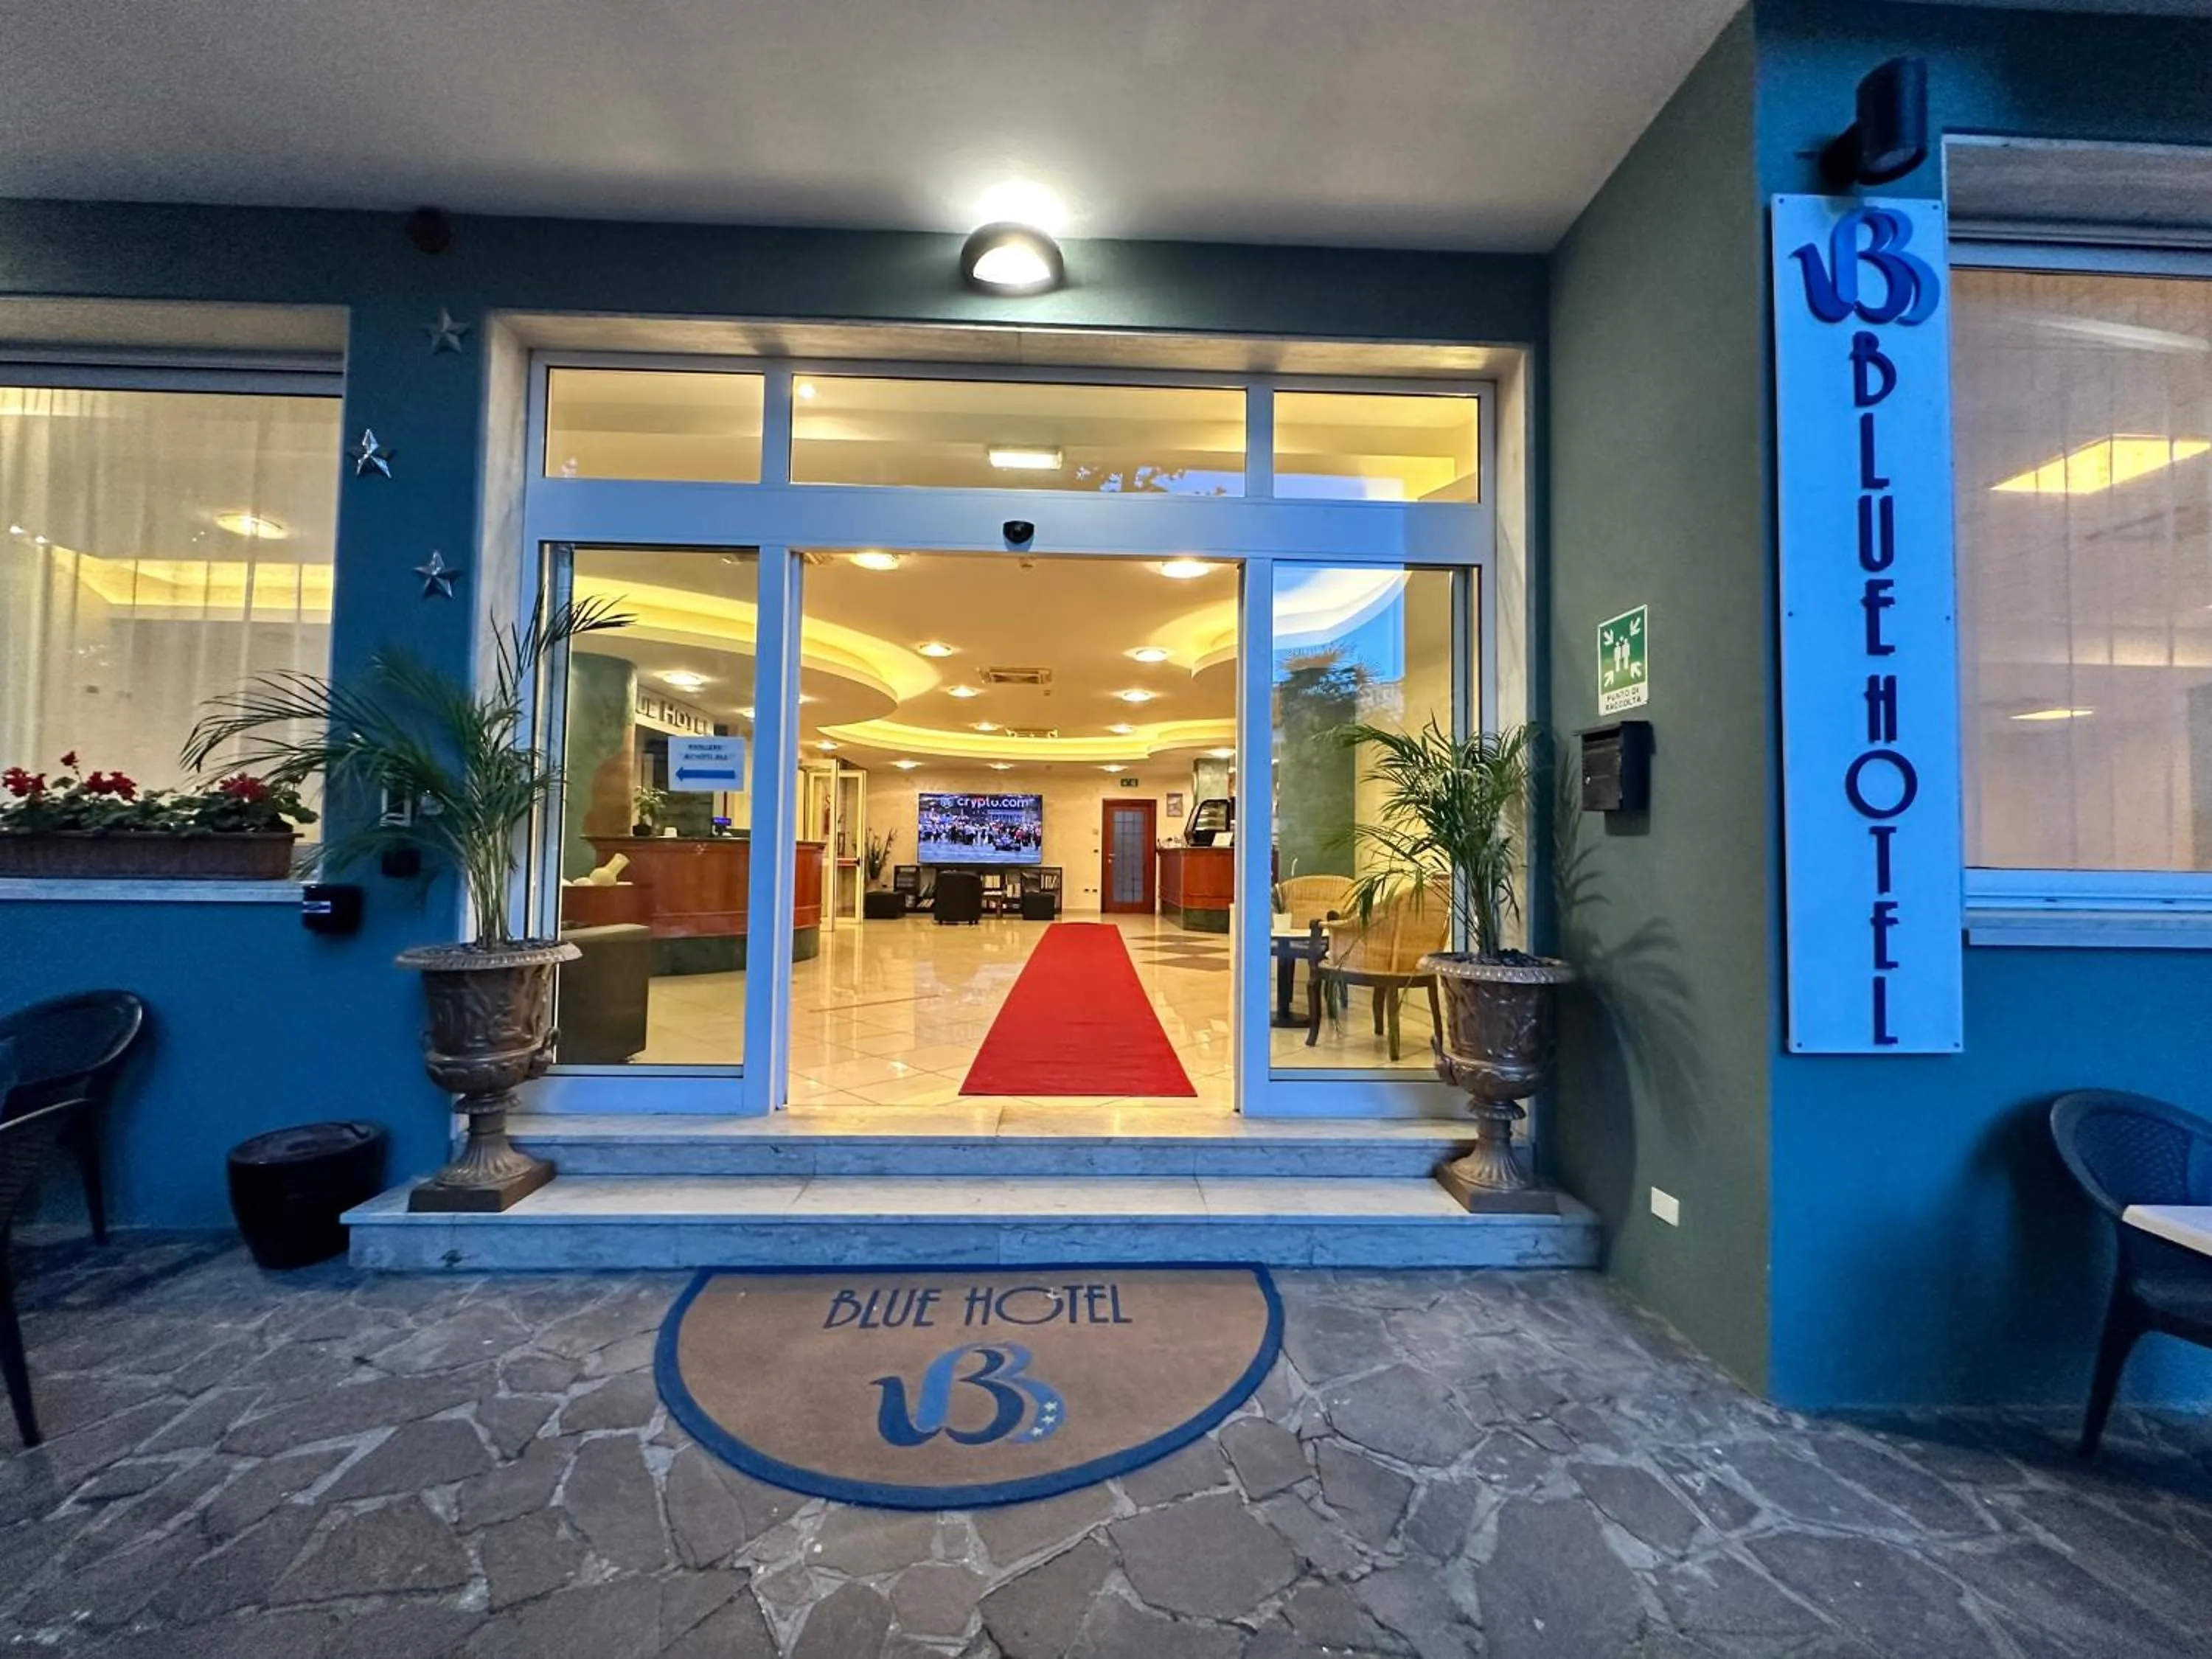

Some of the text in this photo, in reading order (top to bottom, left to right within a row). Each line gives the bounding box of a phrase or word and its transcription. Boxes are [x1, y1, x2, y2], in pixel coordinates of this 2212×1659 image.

[1845, 330, 1917, 1045] BLUE HOTEL
[822, 1284, 1133, 1328] BLUE HOTEL
